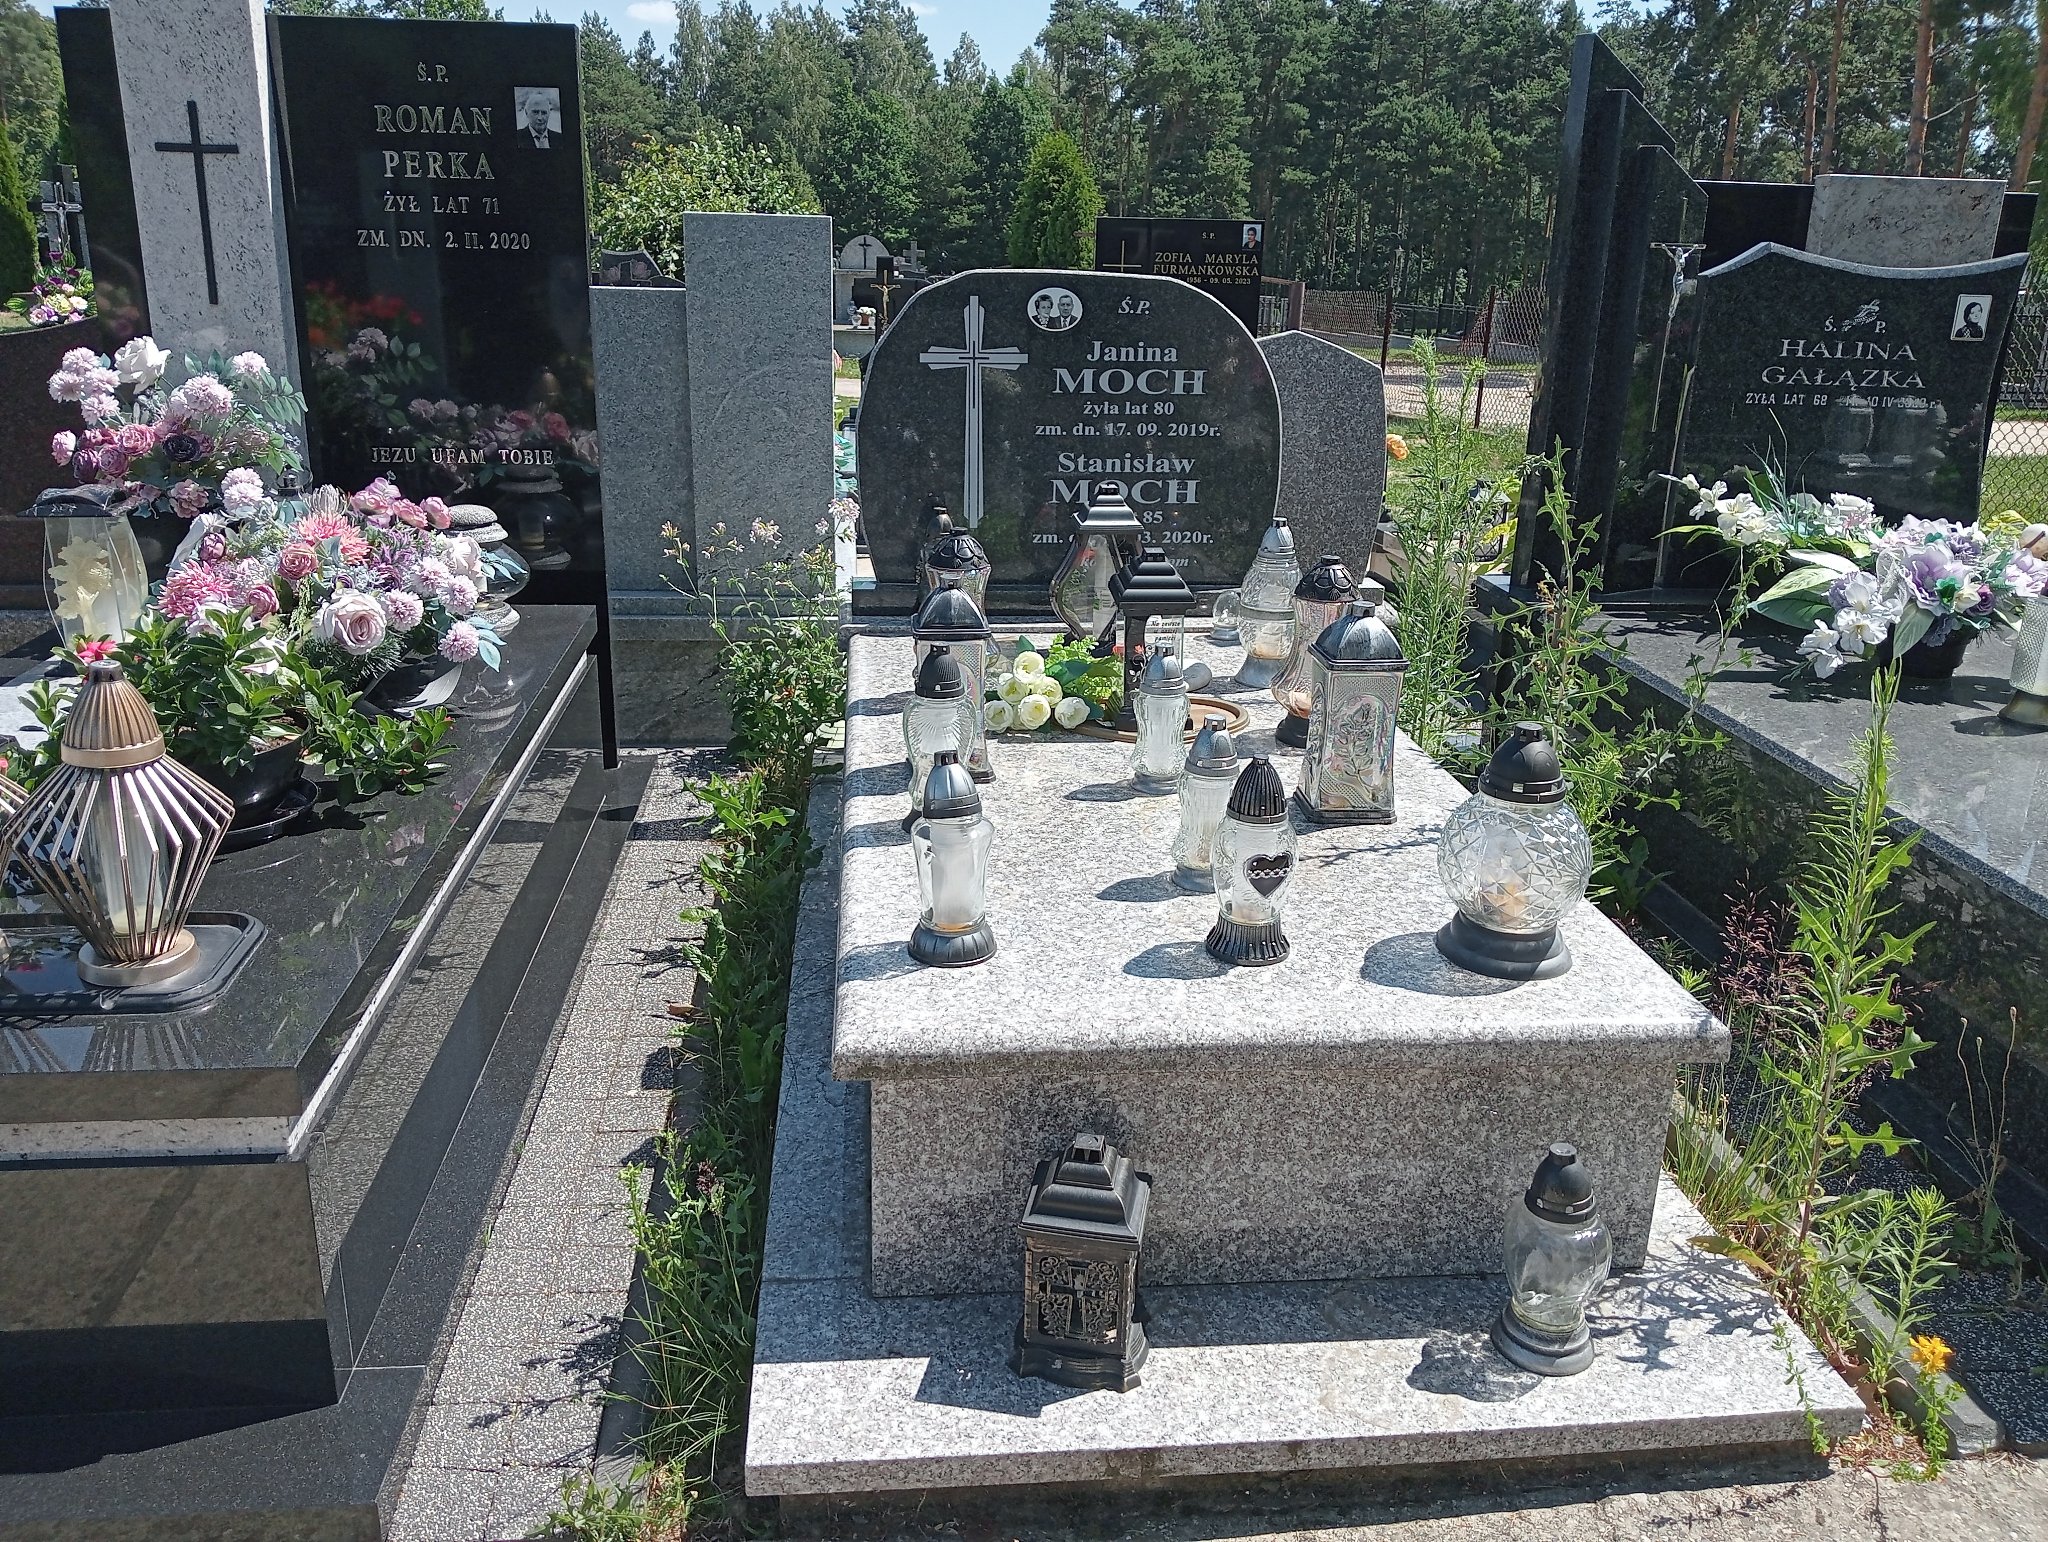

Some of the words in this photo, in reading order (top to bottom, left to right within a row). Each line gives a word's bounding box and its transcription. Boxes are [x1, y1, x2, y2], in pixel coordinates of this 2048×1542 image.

[374, 104, 492, 136] ROMAN
[382, 150, 496, 181] PERKA
[383, 190, 421, 214] ŻYŁ
[432, 196, 471, 215] LAT
[482, 197, 501, 216] 71
[357, 229, 390, 249] ZM.
[399, 230, 432, 249] DN.
[490, 232, 531, 251] 2020
[1154, 252, 1193, 264] ZOFIA
[1204, 253, 1259, 265] MARYLA
[1153, 264, 1259, 276] FURMANKOWSKA
[1085, 340, 1179, 363] Janina
[1779, 338, 1917, 361] HALINA
[1051, 368, 1207, 396] MOCH
[1761, 365, 1926, 391] GAŁĄZKA
[1083, 400, 1122, 418] żyła
[1124, 400, 1150, 416] lat
[1152, 401, 1175, 417] 80
[1783, 393, 1806, 406] LAT
[1813, 394, 1828, 406] 68
[1882, 396, 1895, 408] IV
[1034, 424, 1067, 437] zm.
[1072, 422, 1100, 437] dn.
[1136, 423, 1164, 437] 09.
[1168, 422, 1221, 438] 2019r.
[371, 446, 417, 464] JEZU
[431, 447, 487, 466] UFAM
[498, 448, 555, 466] TOBIE
[1058, 451, 1196, 474] Stanisław
[1142, 510, 1164, 524] 85
[1032, 533, 1064, 544] zm.
[1161, 530, 1215, 544] 2020r.
